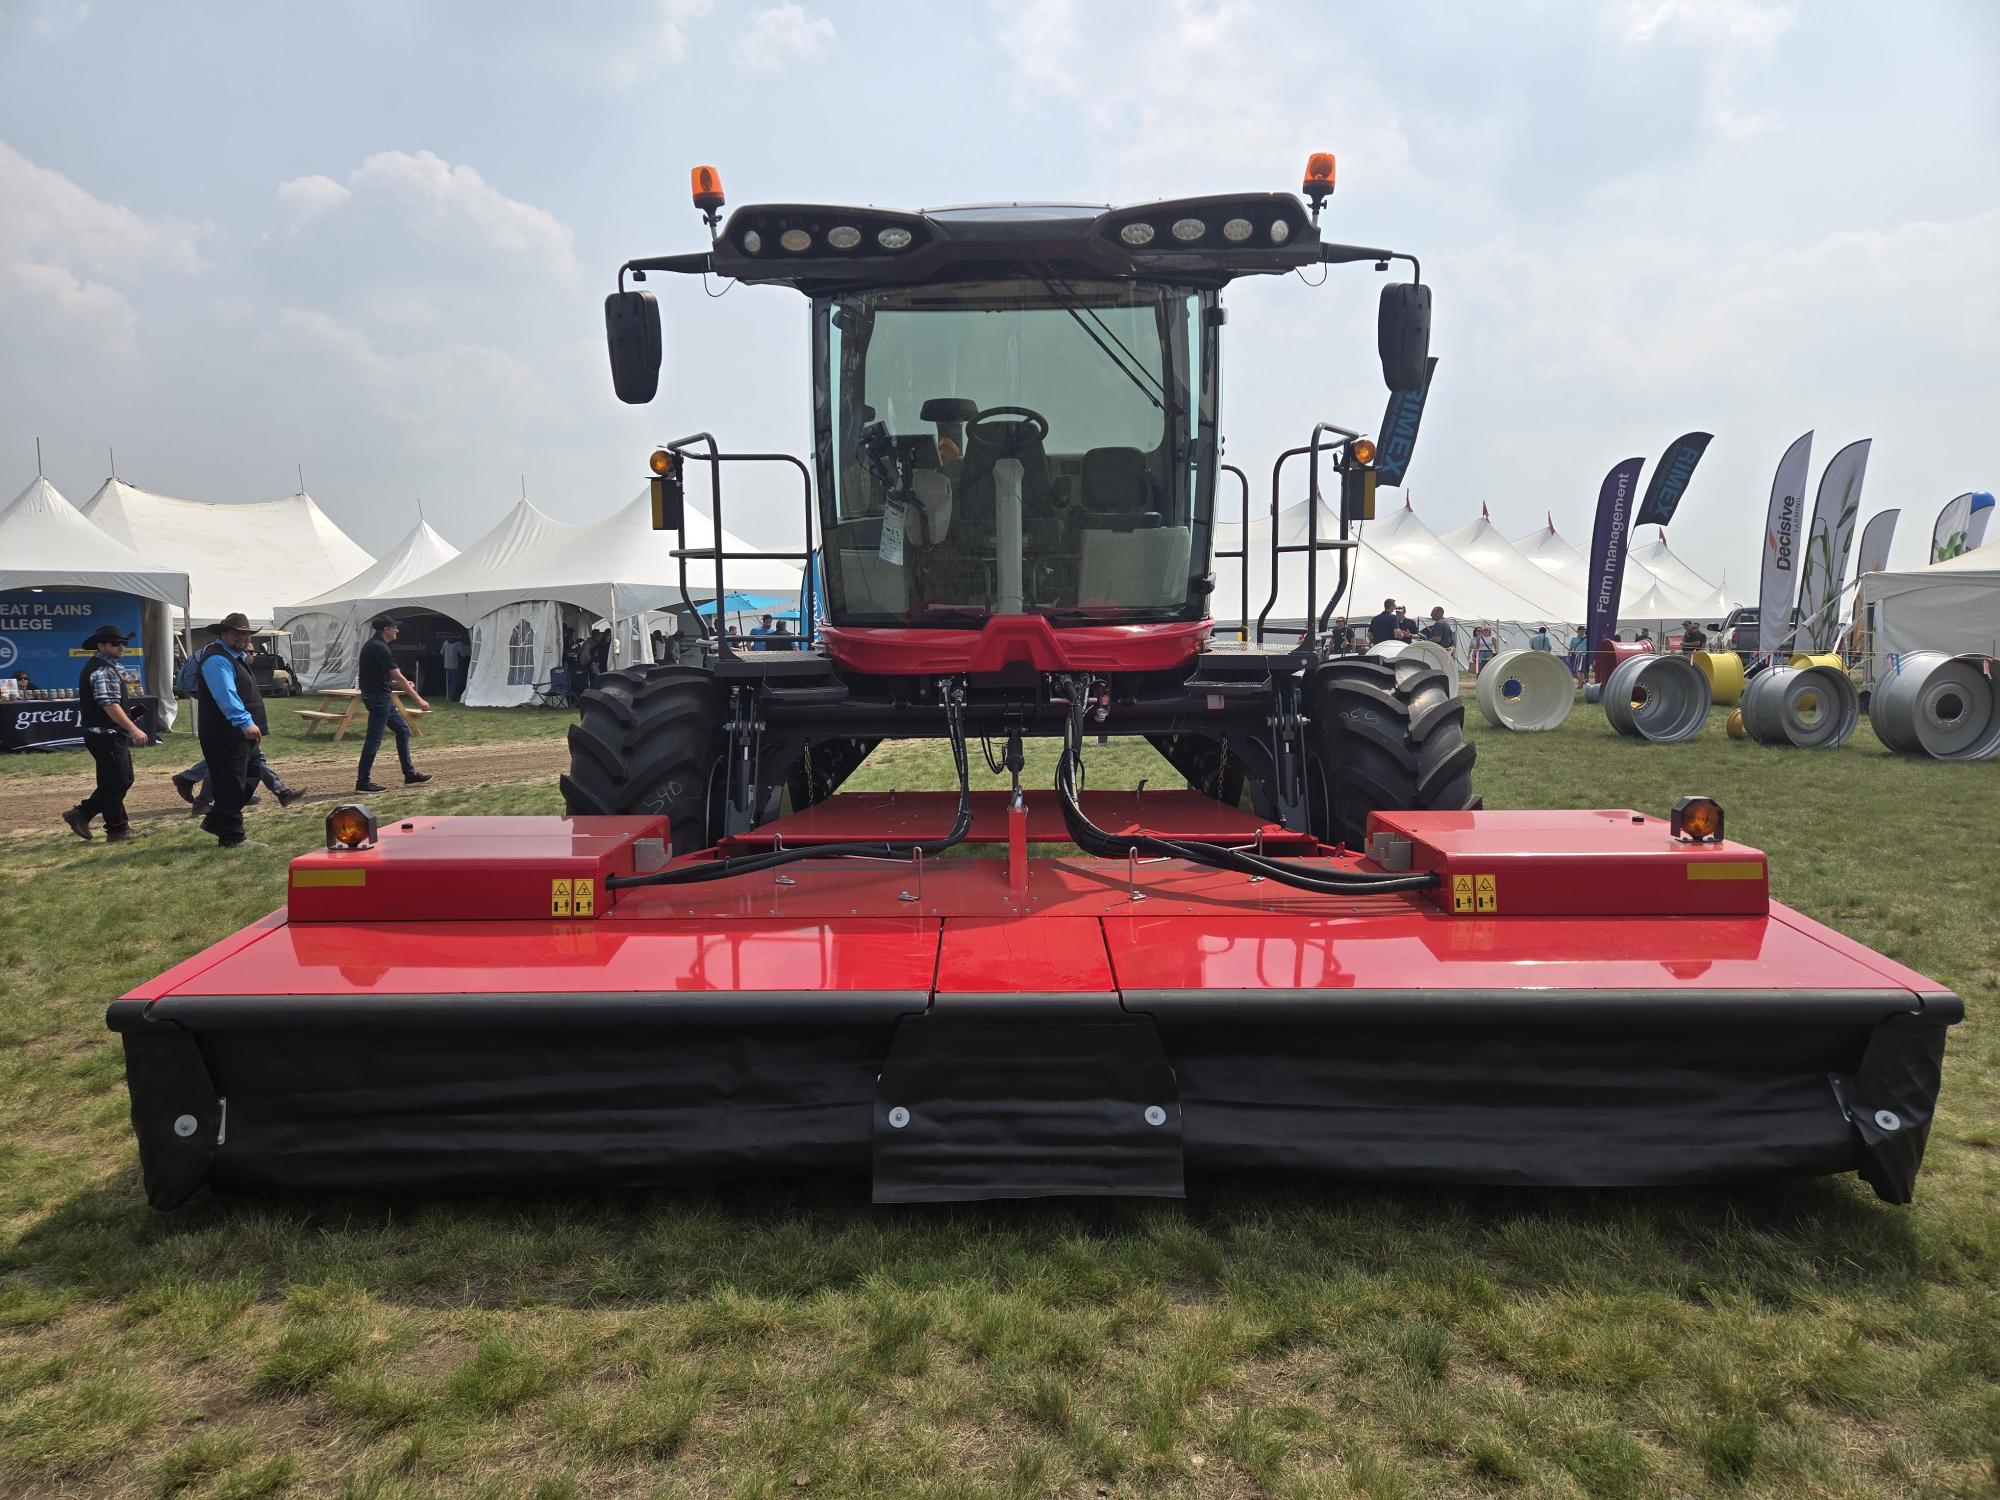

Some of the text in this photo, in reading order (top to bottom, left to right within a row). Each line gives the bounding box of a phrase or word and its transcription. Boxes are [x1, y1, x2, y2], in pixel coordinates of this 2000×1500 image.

[1655, 446, 1698, 519] RIMEX
[1597, 473, 1630, 613] Farm management
[1776, 495, 1795, 571] Decisive
[33, 604, 92, 616] PLAINS
[15, 708, 73, 730] great
